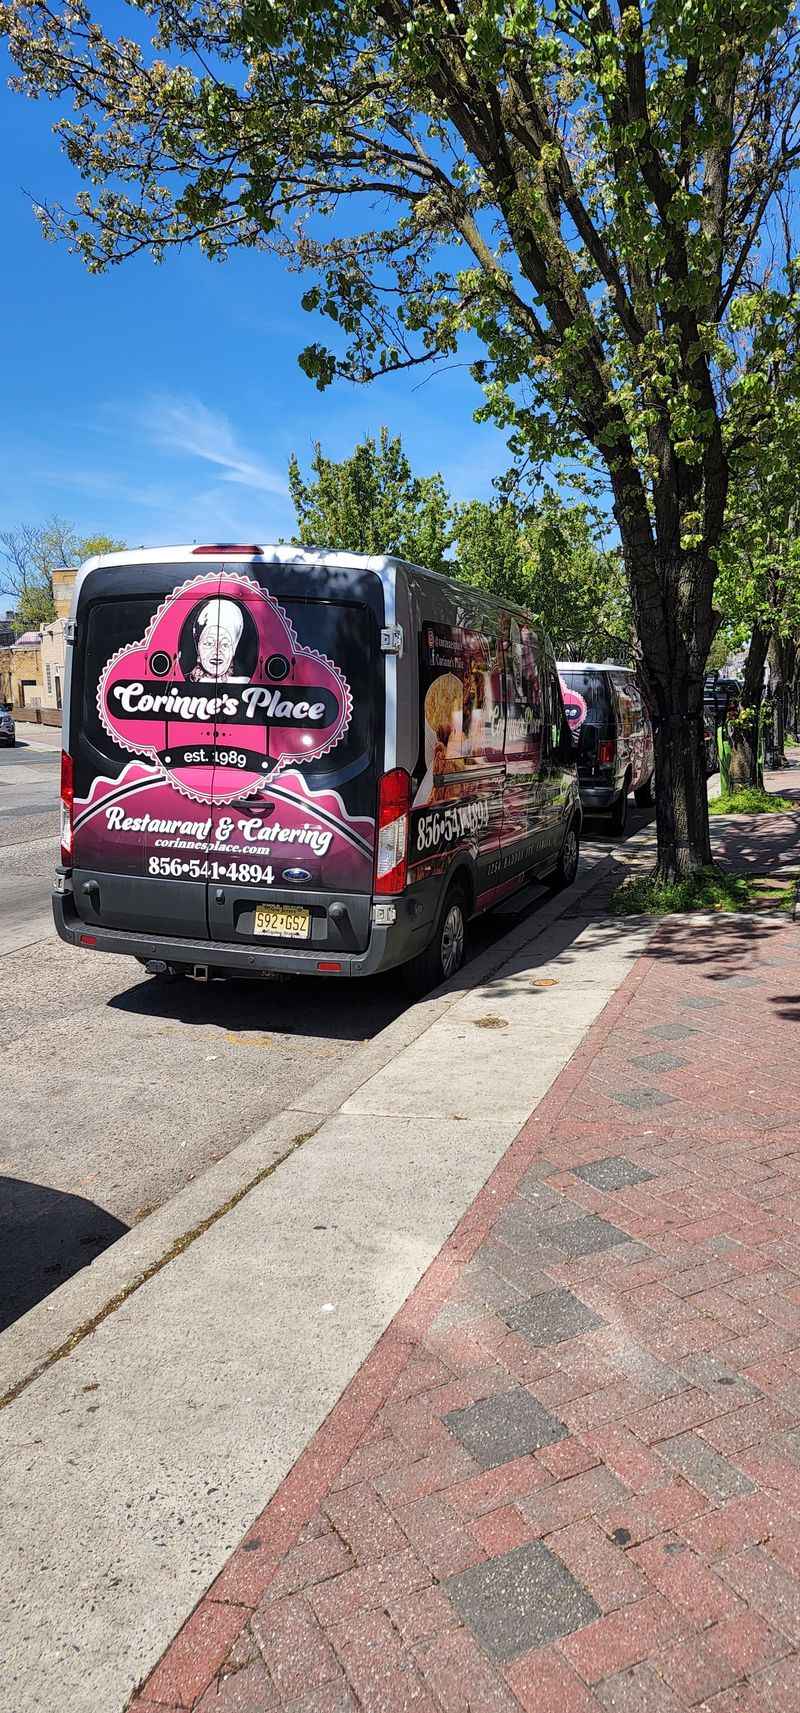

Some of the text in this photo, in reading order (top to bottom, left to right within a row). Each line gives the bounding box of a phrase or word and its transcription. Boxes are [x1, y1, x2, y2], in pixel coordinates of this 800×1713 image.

[113, 682, 326, 720] Corinne's Place
[183, 749, 247, 768] est. 1989
[105, 806, 333, 856] Restaurant & Catering
[154, 837, 271, 855] corinnesplace.com
